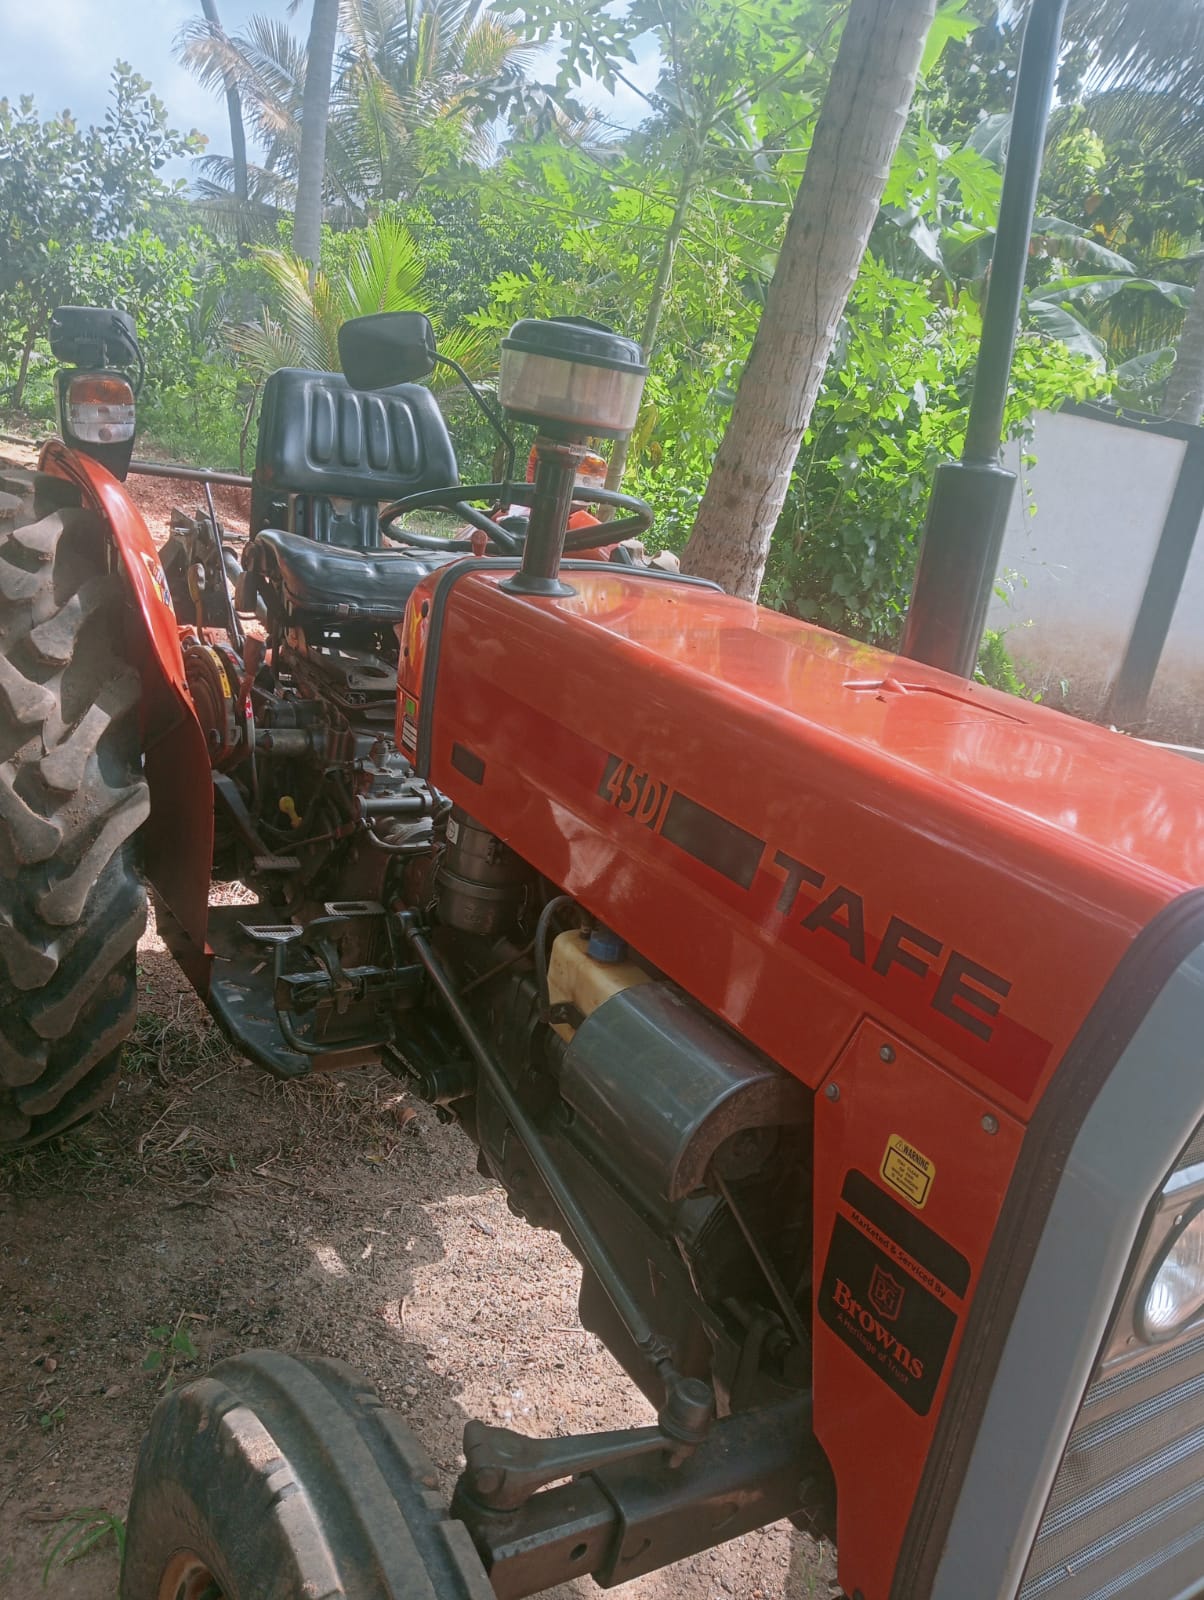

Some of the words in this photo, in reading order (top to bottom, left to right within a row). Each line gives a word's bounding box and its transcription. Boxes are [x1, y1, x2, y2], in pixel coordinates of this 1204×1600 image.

[774, 849, 1012, 1042] TAFE
[903, 1144, 930, 1171] WARNING
[851, 1211, 890, 1248] Marketed
[890, 1245, 897, 1255] &
[897, 1251, 934, 1287] Serviced
[934, 1284, 947, 1298] By
[832, 1278, 924, 1379] Browns
